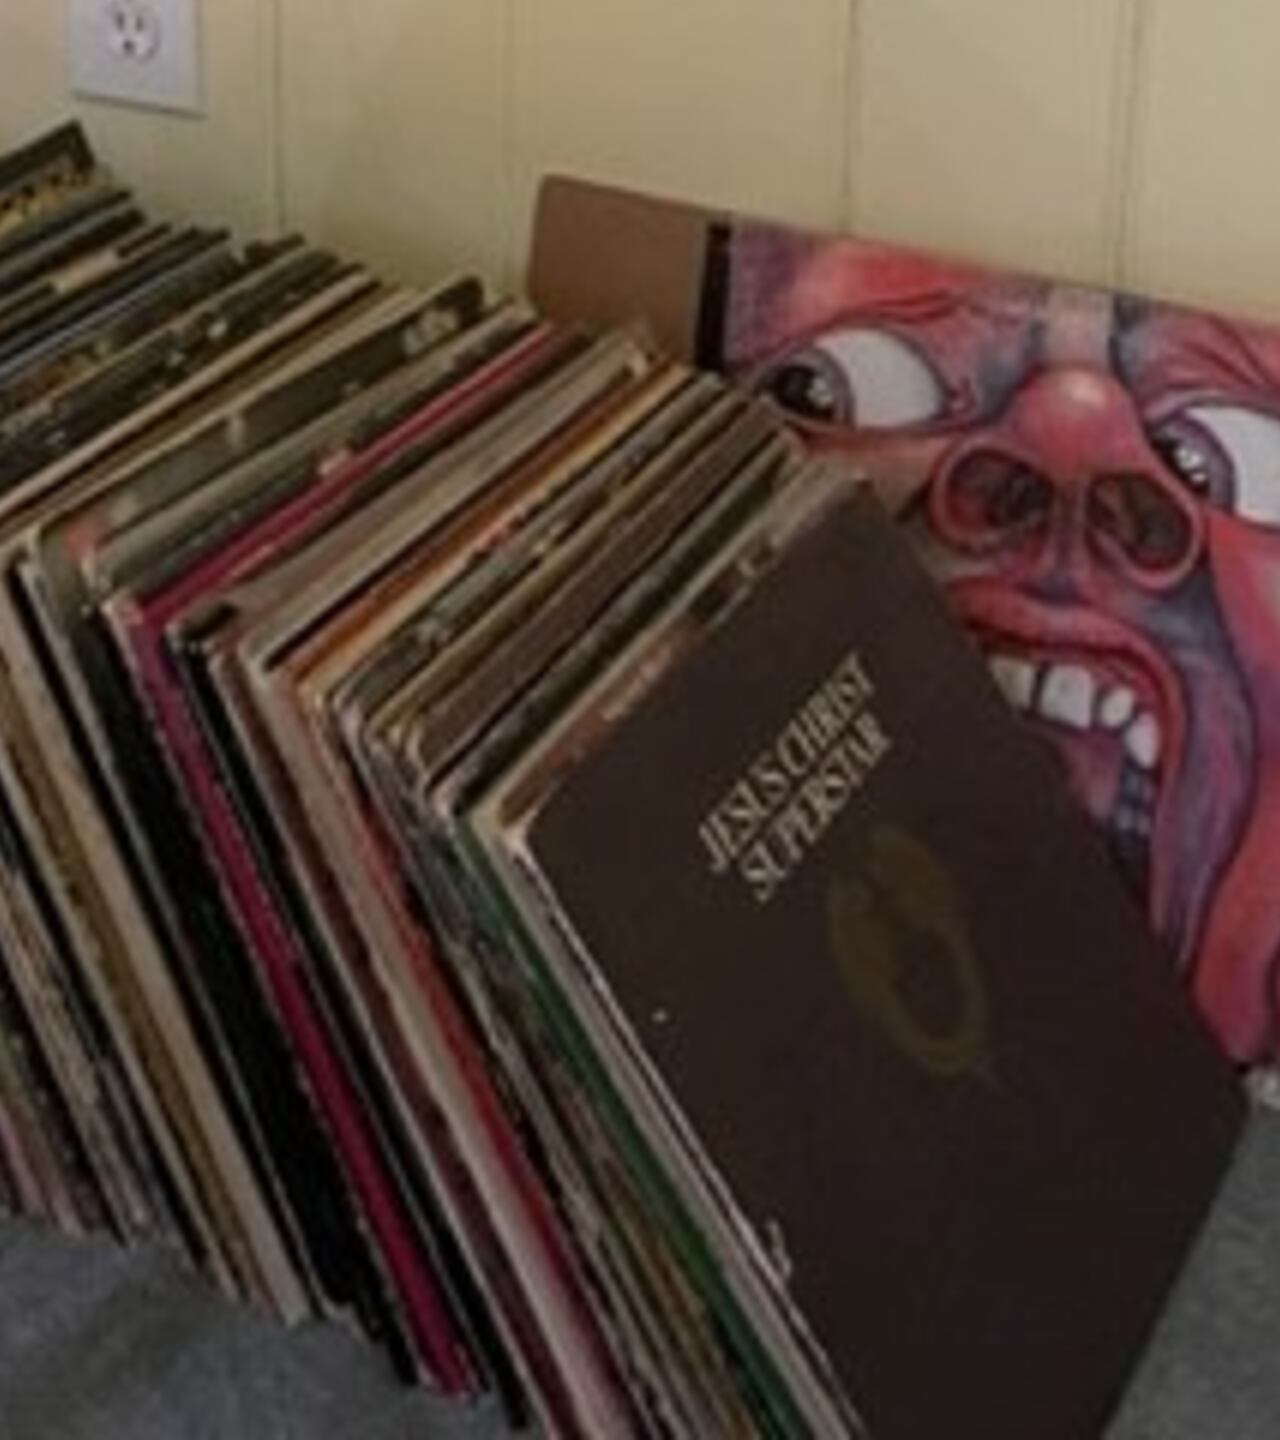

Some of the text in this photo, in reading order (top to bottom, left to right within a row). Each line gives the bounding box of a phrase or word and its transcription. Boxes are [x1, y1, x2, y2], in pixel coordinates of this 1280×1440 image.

[700, 653, 873, 871] JESUS CHRIST
[745, 712, 889, 900] SUPERSTAR
